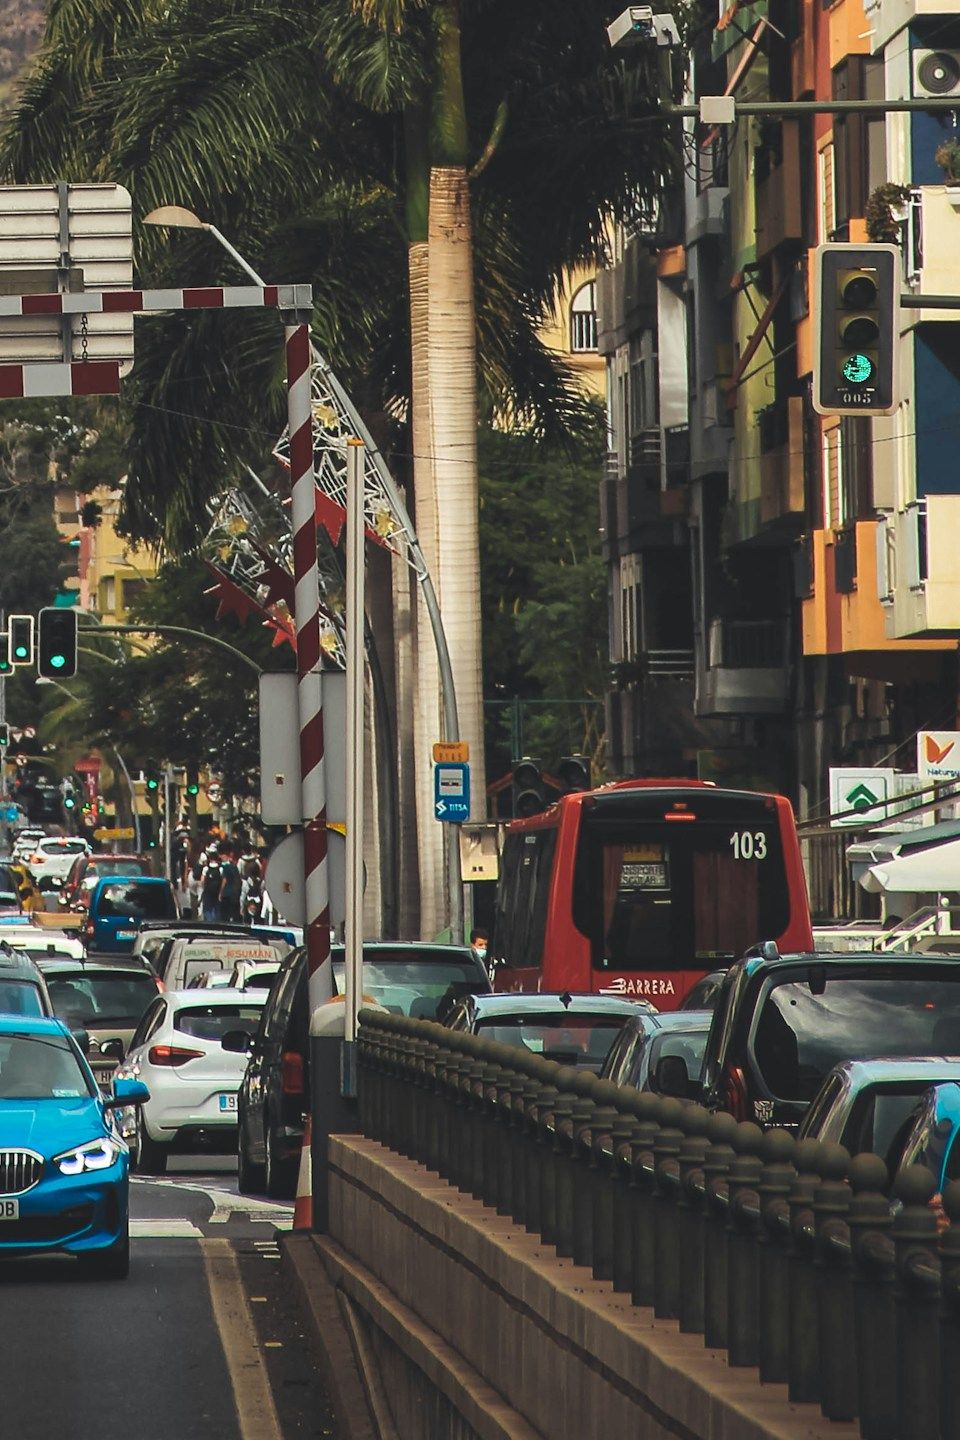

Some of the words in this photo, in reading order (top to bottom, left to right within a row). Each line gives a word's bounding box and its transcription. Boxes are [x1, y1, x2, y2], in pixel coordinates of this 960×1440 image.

[843, 393, 871, 403] 005
[449, 803, 468, 812] TITSA
[729, 831, 767, 860] 103
[619, 978, 675, 995] BARRERA
